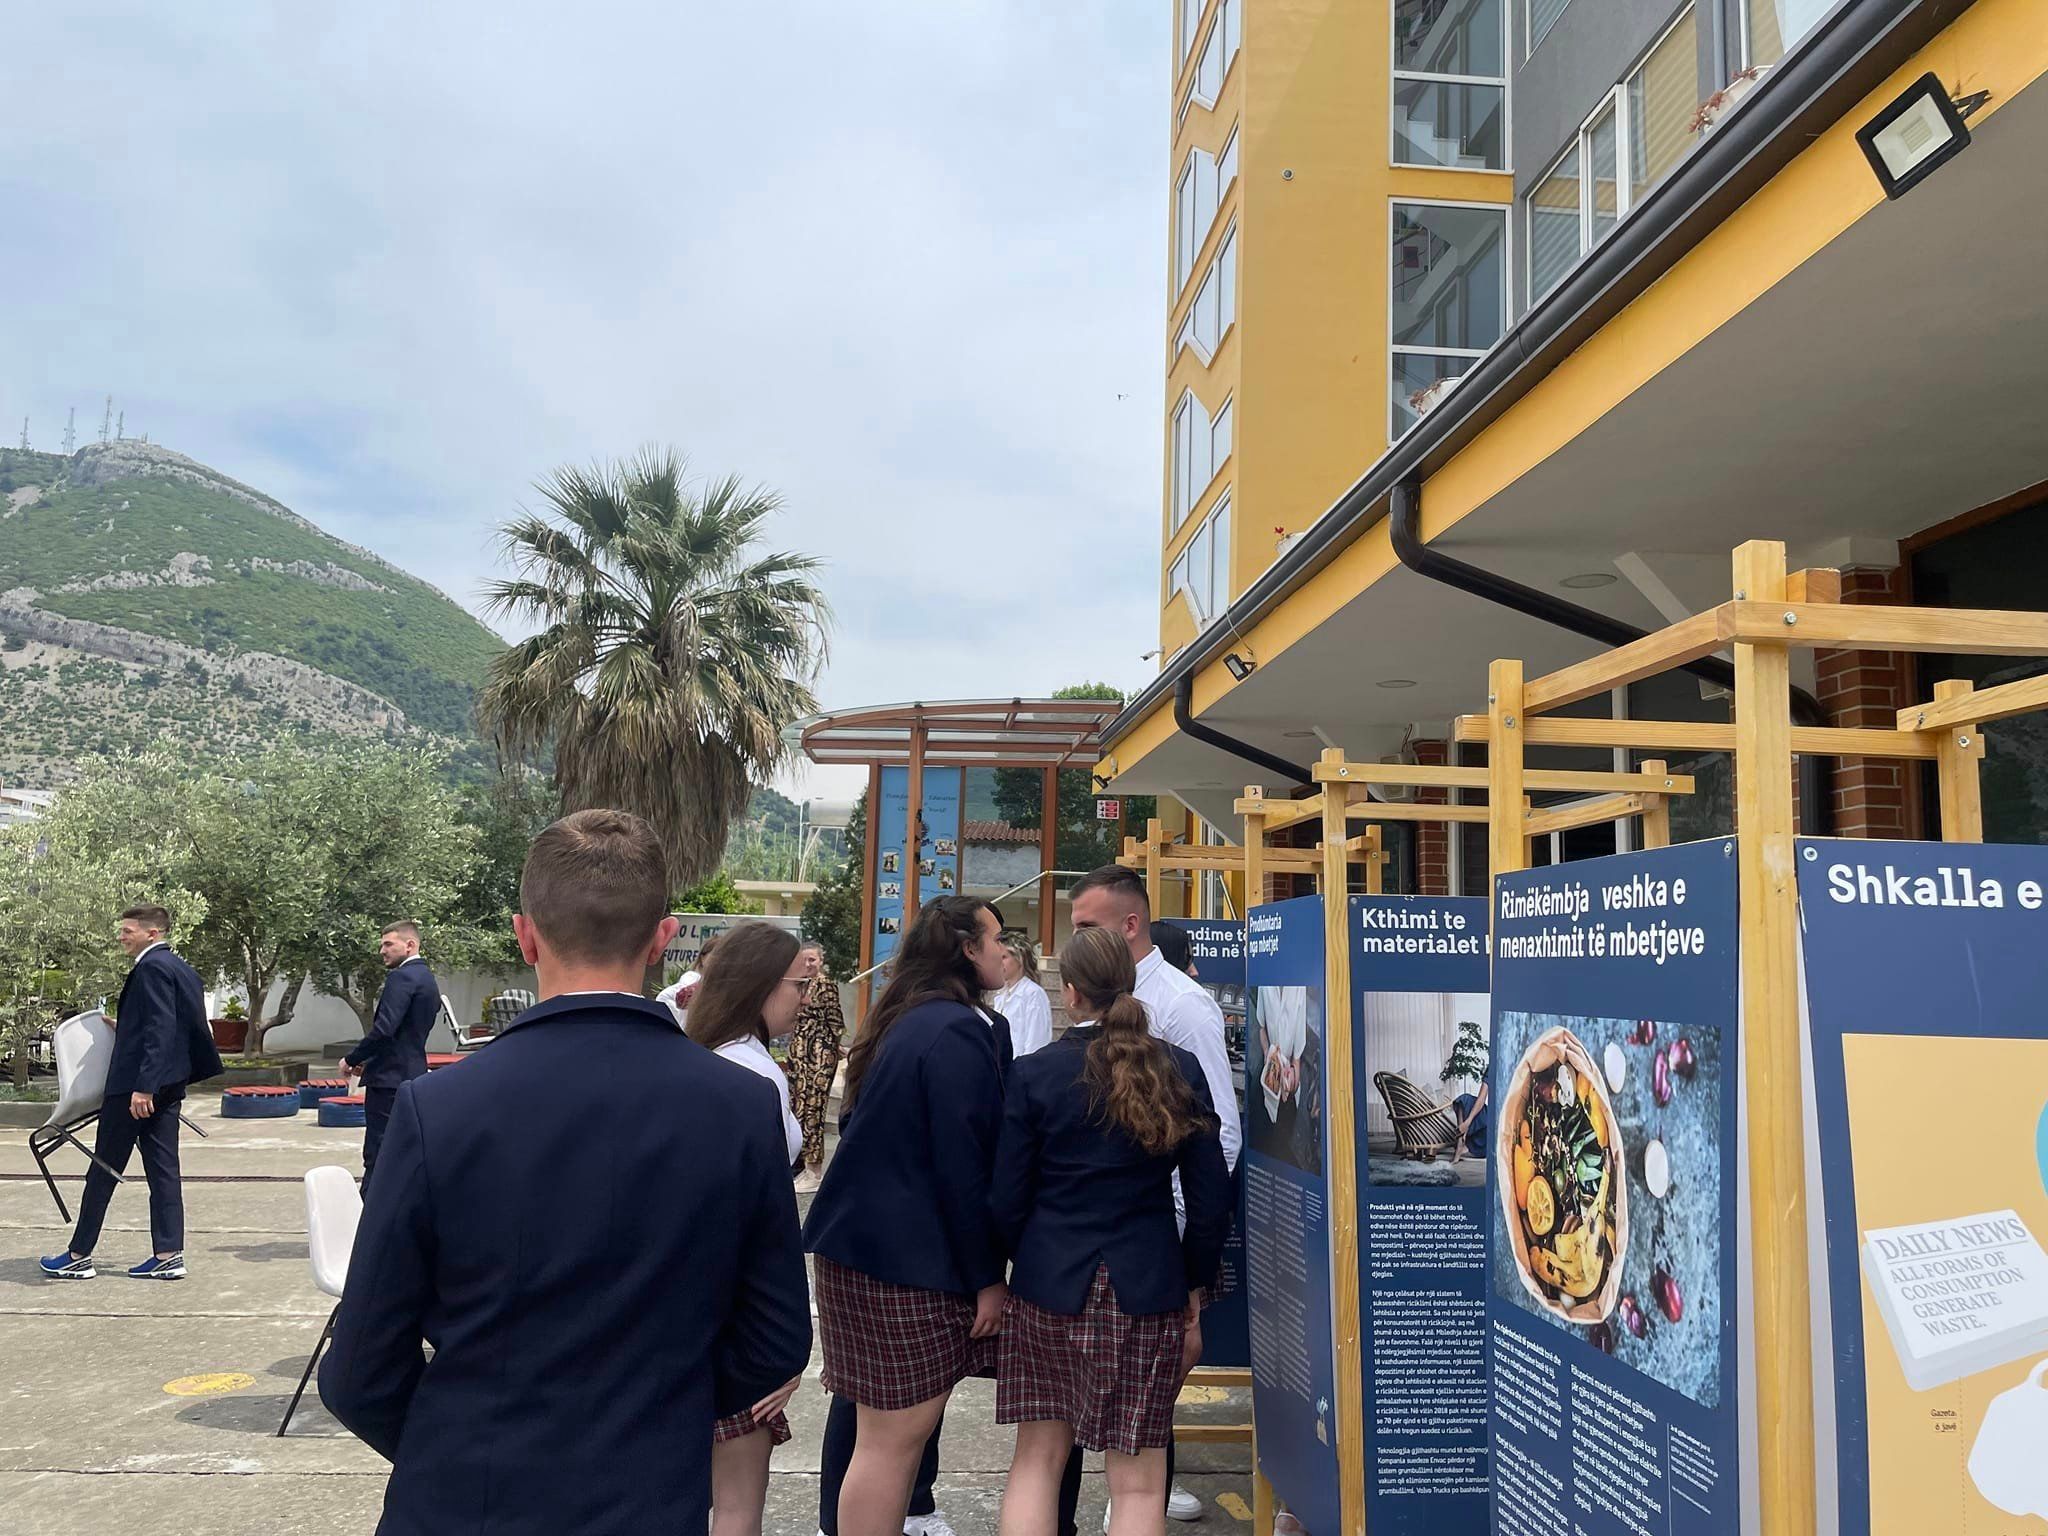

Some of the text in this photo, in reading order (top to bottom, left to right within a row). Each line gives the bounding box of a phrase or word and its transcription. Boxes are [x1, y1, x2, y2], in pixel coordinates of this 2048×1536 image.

[1501, 873, 1686, 921] Rimëkëmbja veshka e
[1828, 863, 2044, 910] Shkalla e
[1362, 908, 1466, 930] Kthimi te
[1187, 927, 1234, 942] ndime
[1363, 933, 1479, 954] materialet
[1500, 926, 1585, 959] menaxhimit
[1588, 923, 1605, 957] të
[1610, 920, 1705, 965] mbetjeve
[1193, 943, 1218, 957] dha
[1222, 943, 1240, 958] në
[1875, 1218, 2027, 1260] DAILY NEWS
[1890, 1251, 2008, 1284] ALL FORMS OF
[1901, 1267, 2025, 1301] CONSUMPTION
[1912, 1291, 2003, 1319] GENERATE
[1921, 1314, 1987, 1337] WASTE.
